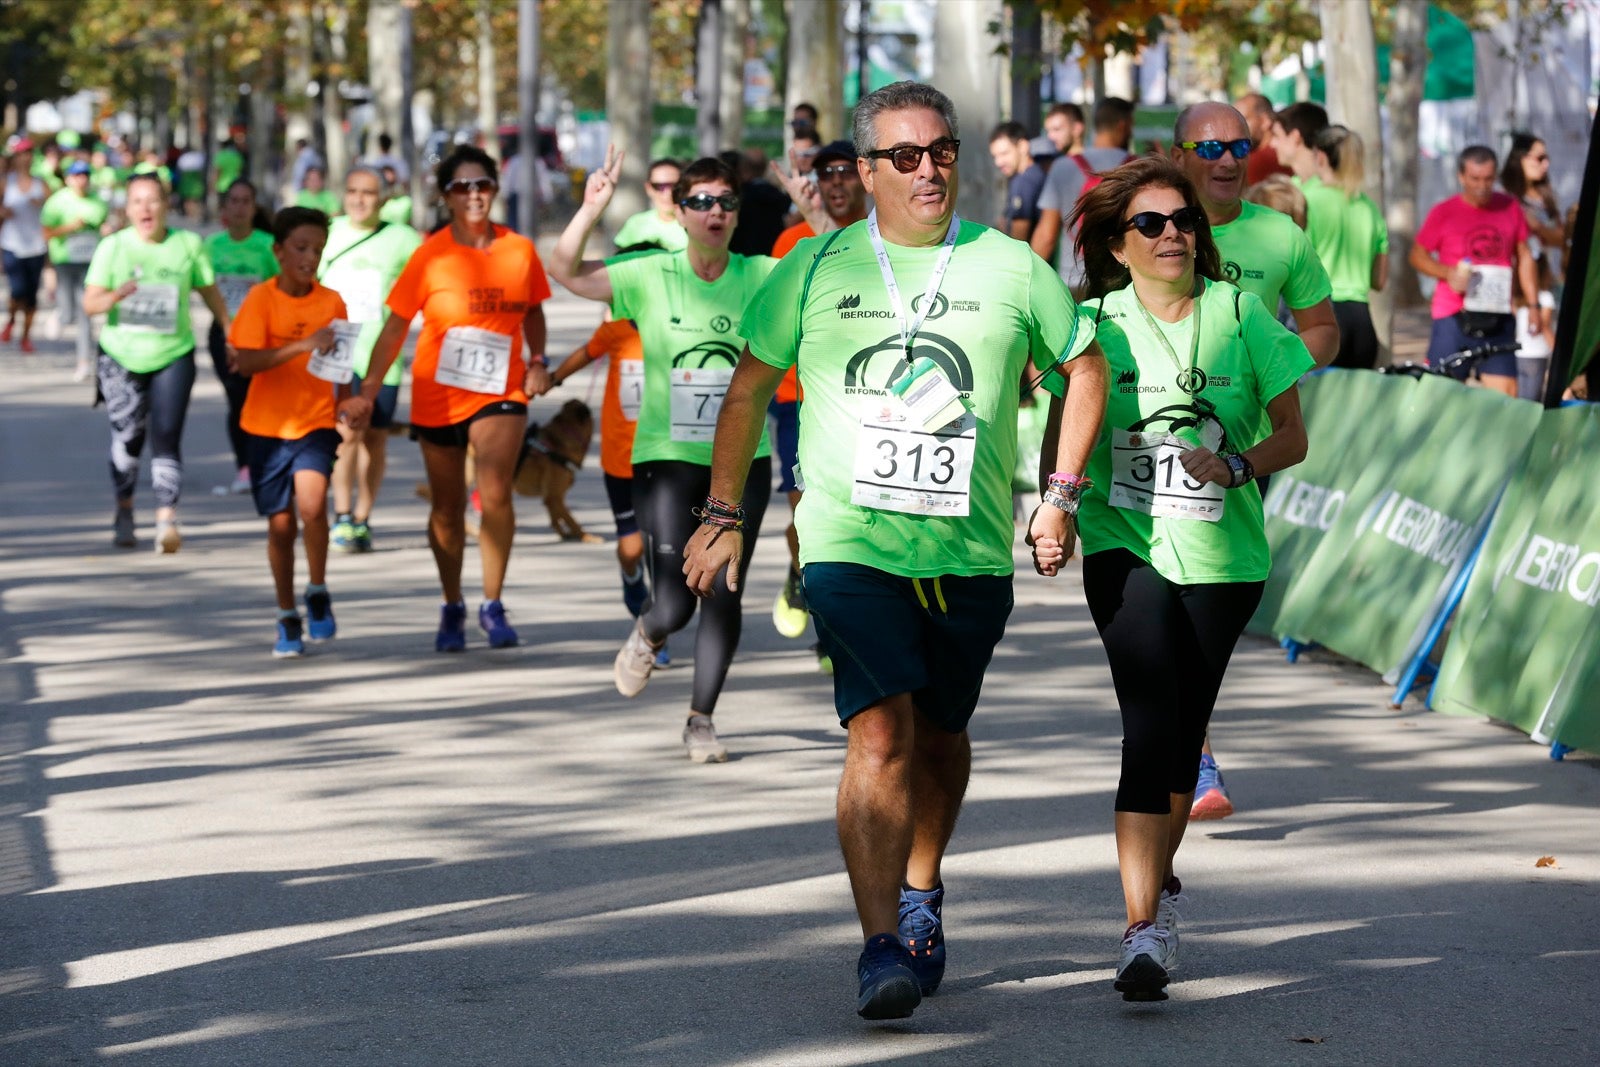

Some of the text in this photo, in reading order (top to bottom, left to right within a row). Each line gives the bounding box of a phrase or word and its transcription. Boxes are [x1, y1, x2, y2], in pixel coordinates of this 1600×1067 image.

[453, 346, 496, 375] 113
[858, 388, 888, 396] FORMA
[873, 439, 955, 485] 313
